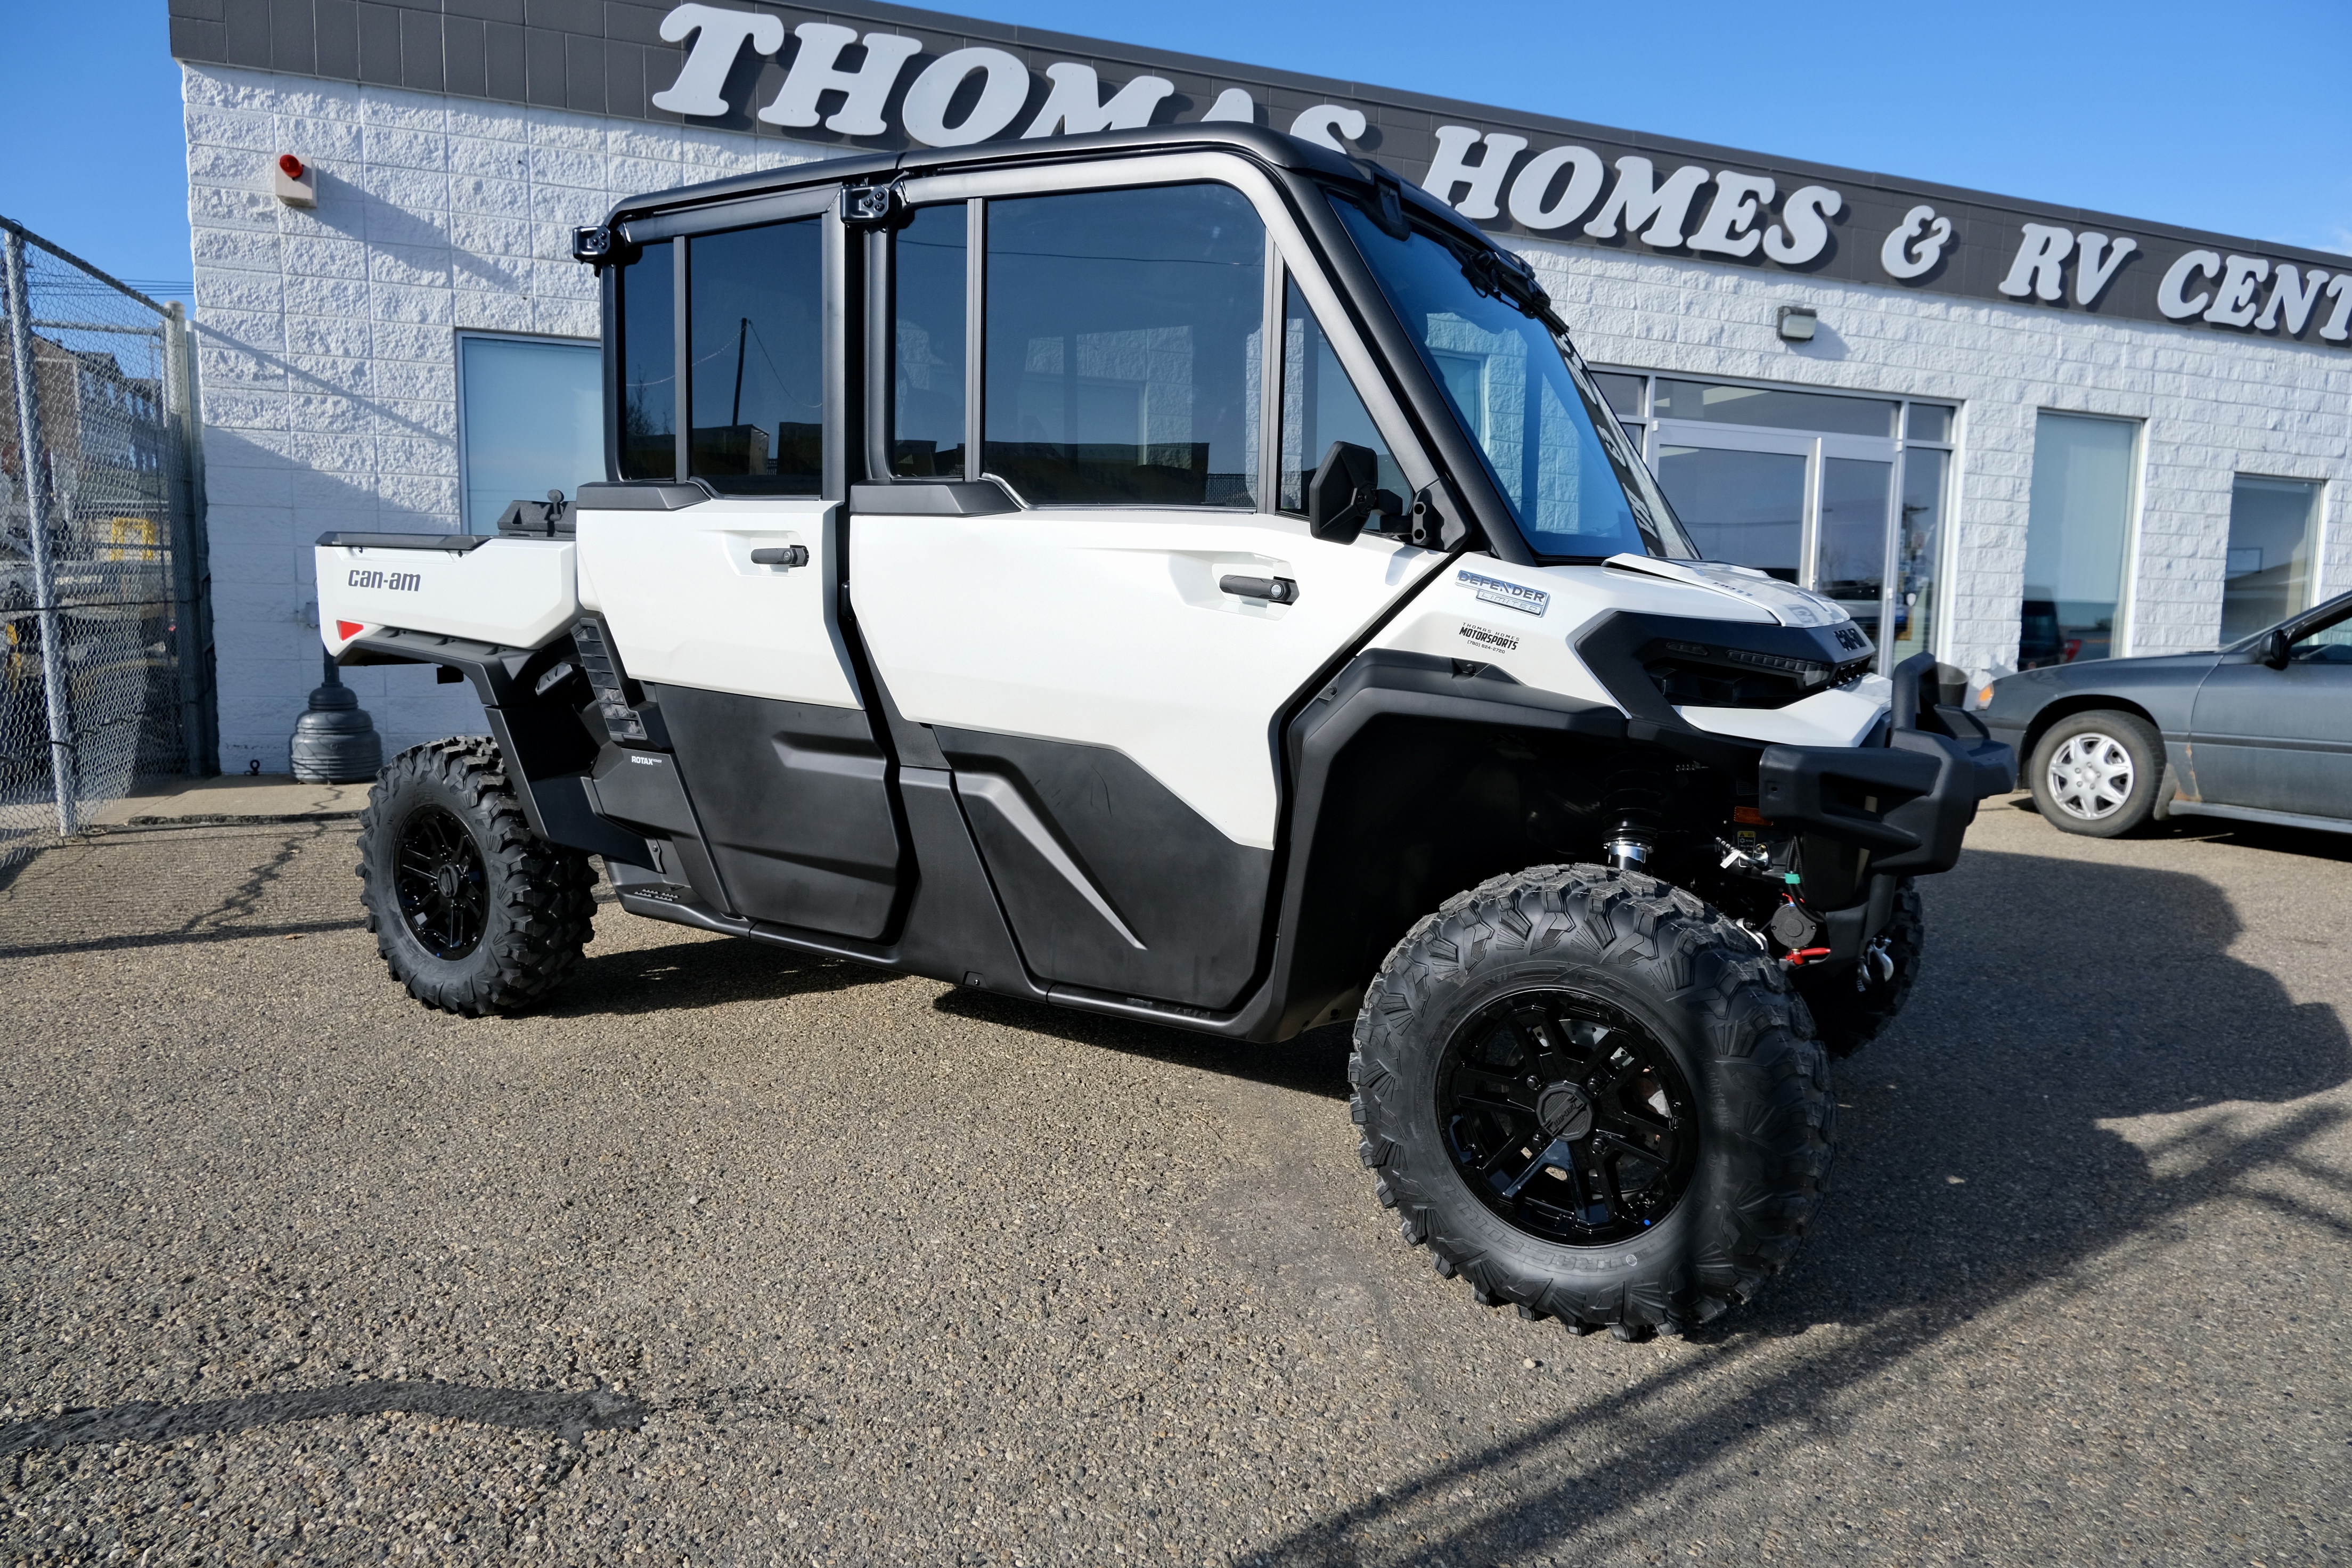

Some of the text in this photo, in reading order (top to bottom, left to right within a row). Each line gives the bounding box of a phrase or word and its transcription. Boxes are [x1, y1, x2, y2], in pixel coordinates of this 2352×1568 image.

[1421, 125, 1842, 264] HOMES
[1881, 205, 1951, 278] &
[1998, 223, 2137, 305] RV
[348, 569, 421, 592] can-am
[1458, 571, 1545, 602] DEFENDER
[1481, 592, 1539, 612] LIMITED
[1459, 626, 1518, 650] MOTORSPORTS
[1463, 622, 1520, 641] THOMAS HOMES
[631, 756, 653, 765] ROTAX
